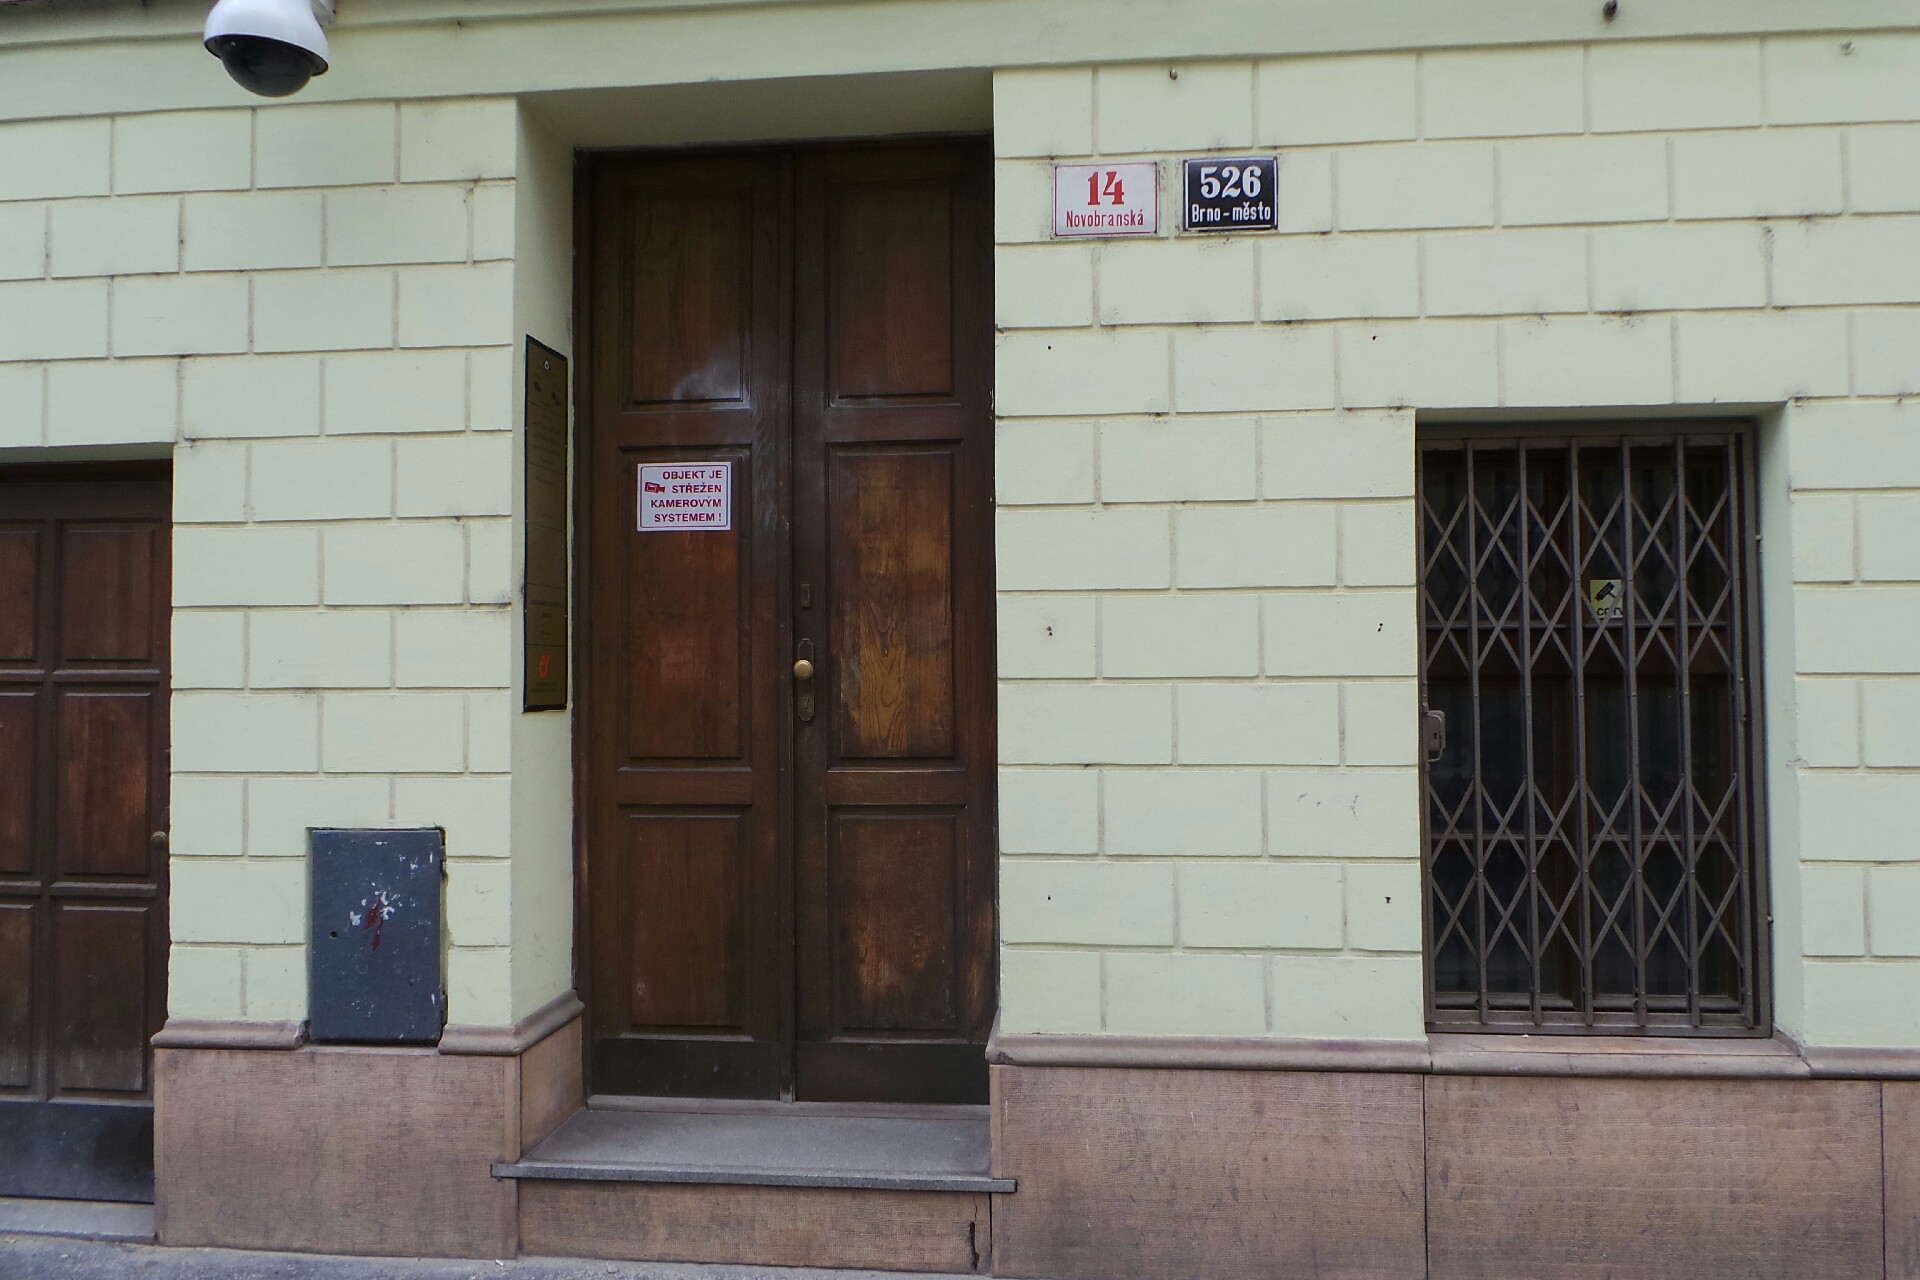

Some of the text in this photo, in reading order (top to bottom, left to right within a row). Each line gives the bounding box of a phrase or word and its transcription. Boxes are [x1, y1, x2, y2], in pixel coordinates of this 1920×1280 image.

[1087, 171, 1125, 206] 14
[1200, 166, 1262, 199] 526
[1066, 208, 1144, 228] Novobranská
[662, 470, 722, 480] OBJEKT JE
[671, 482, 722, 494] STŘEŽEN
[650, 496, 722, 508] KAMEROVÝM
